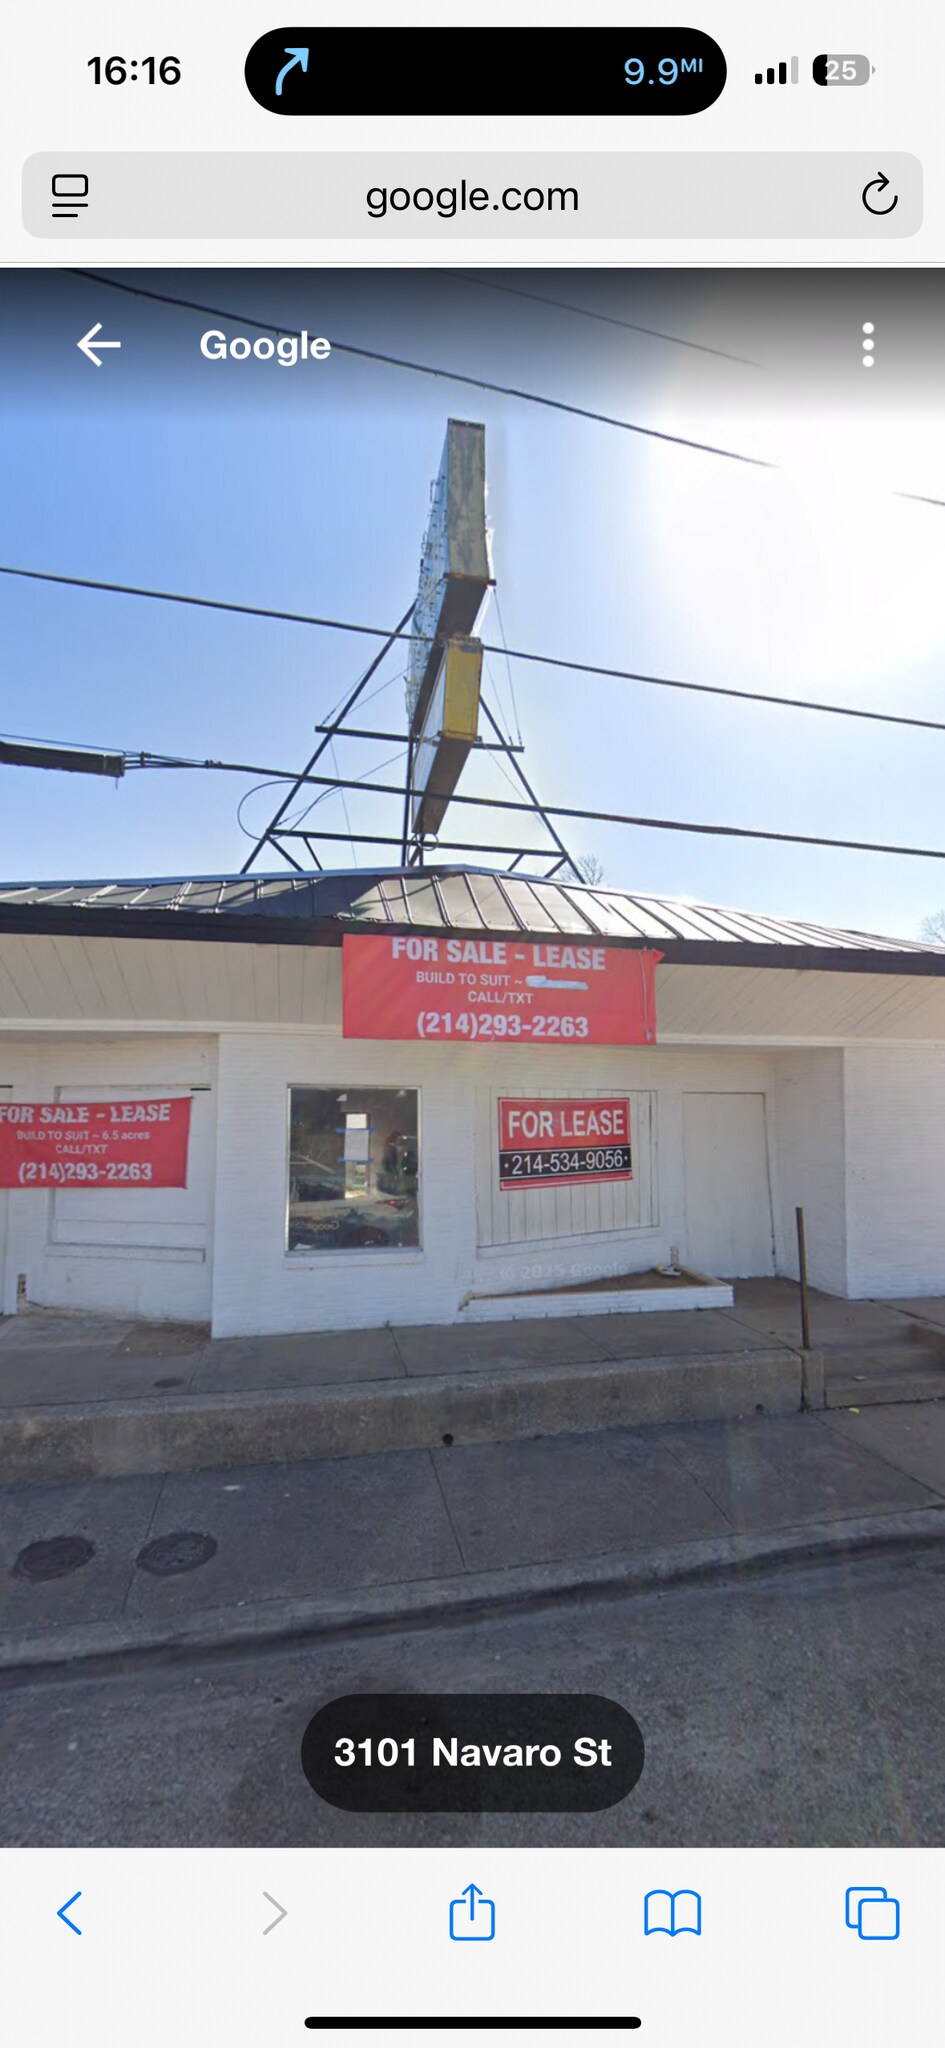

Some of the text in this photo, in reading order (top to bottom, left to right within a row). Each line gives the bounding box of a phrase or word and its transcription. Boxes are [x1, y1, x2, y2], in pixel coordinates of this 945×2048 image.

[391, 937, 440, 962] FOR
[447, 939, 507, 965] SALE
[533, 946, 606, 970] LEASE
[416, 971, 455, 984] BUILD
[459, 973, 477, 985] TO
[480, 974, 511, 987] SUIT
[467, 990, 534, 1005] CALL/TXT
[416, 1011, 589, 1038] (214)293-2263
[0, 1105, 34, 1123] FOR
[39, 1106, 89, 1123] SALE
[110, 1103, 171, 1122] LEASE
[508, 1109, 624, 1138] FOR LEASE
[17, 1131, 45, 1140] BUILD
[48, 1131, 62, 1140] TO
[65, 1131, 90, 1140] SUIT
[102, 1131, 119, 1140] 6.5
[121, 1131, 150, 1140] acres
[55, 1144, 108, 1154] CALL/TXT
[18, 1162, 153, 1183] (214)293-2263
